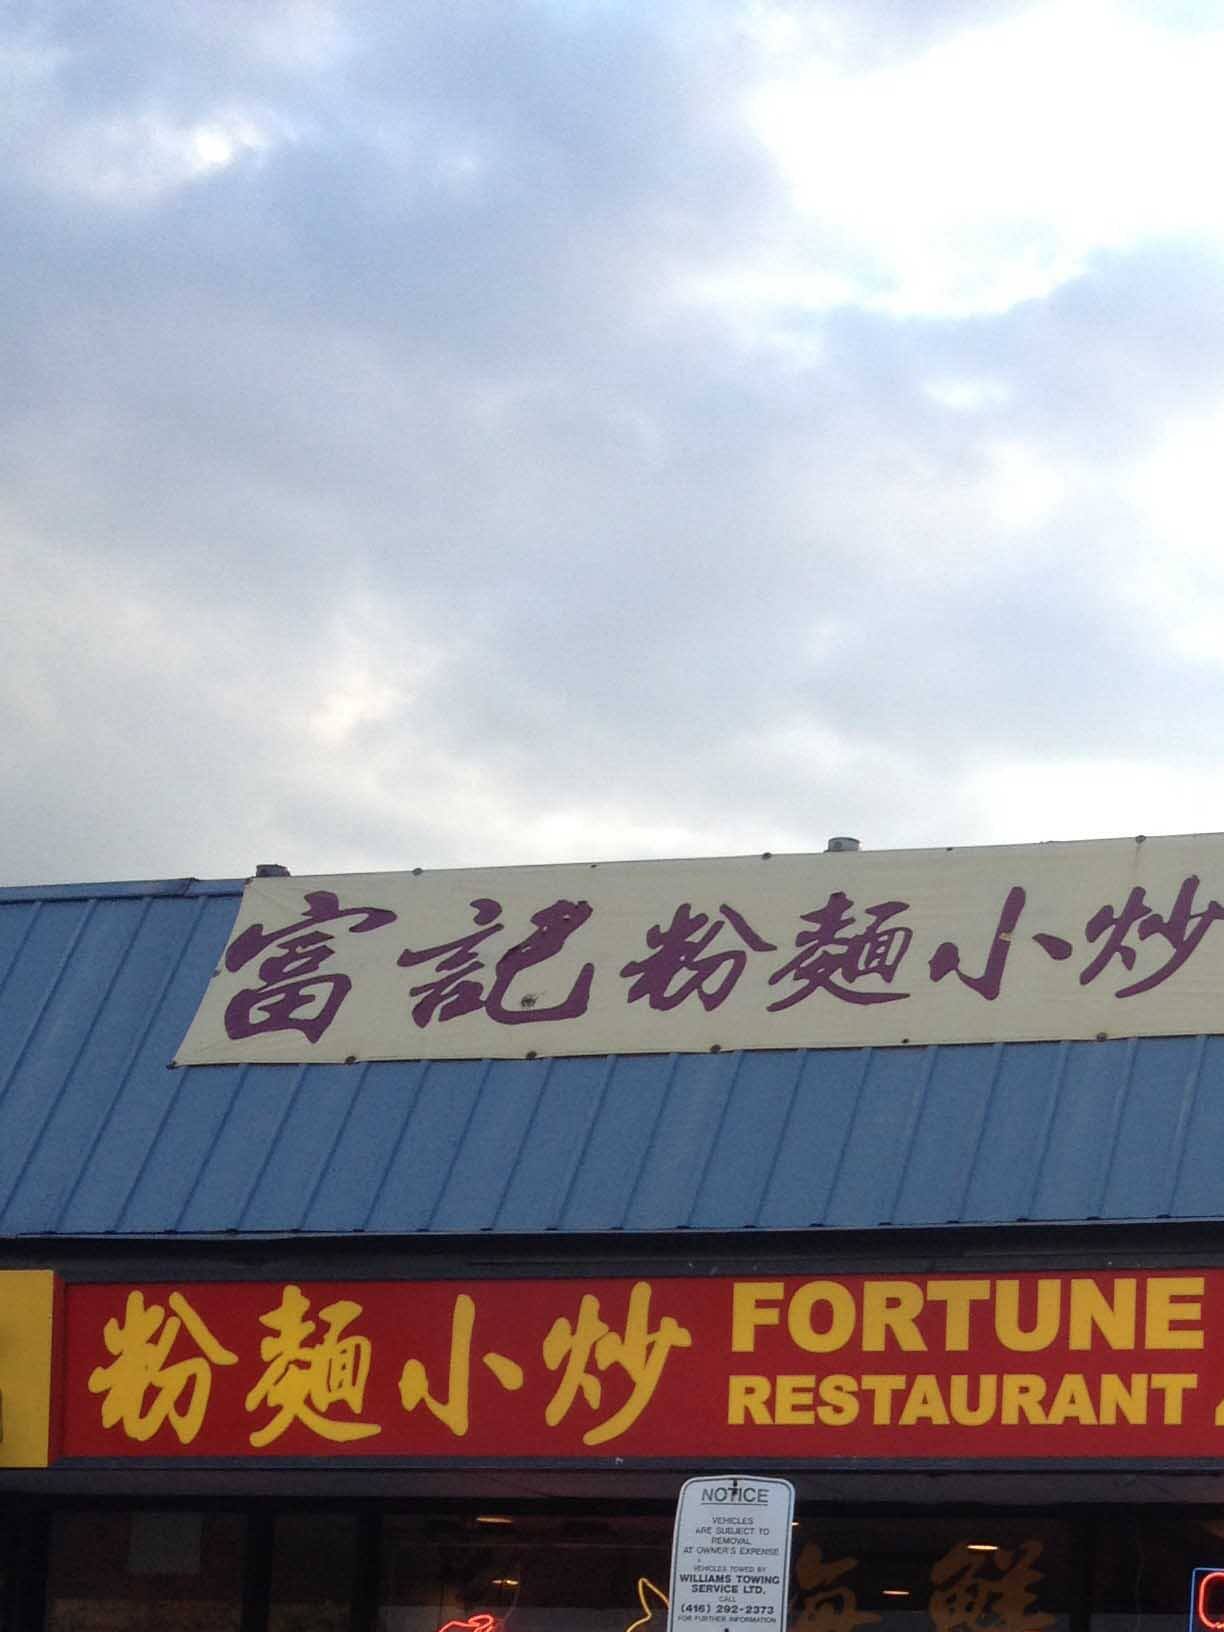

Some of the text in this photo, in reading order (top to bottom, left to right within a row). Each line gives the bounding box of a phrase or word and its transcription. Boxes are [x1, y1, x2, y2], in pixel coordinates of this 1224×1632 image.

[730, 1276, 1206, 1354] FORTUNE
[87, 1280, 692, 1447] 粉麵小炒
[726, 1373, 1199, 1427] RESTAURANT
[701, 1487, 769, 1503] NOTICE
[712, 1516, 754, 1525] VEHICLES
[696, 1527, 770, 1536] ARE SUBJECT TO
[679, 1574, 780, 1585] WILLIAMS TOWING
[691, 1584, 767, 1595] SERVICE LTD.
[680, 1603, 775, 1615] (416) 292-2373
